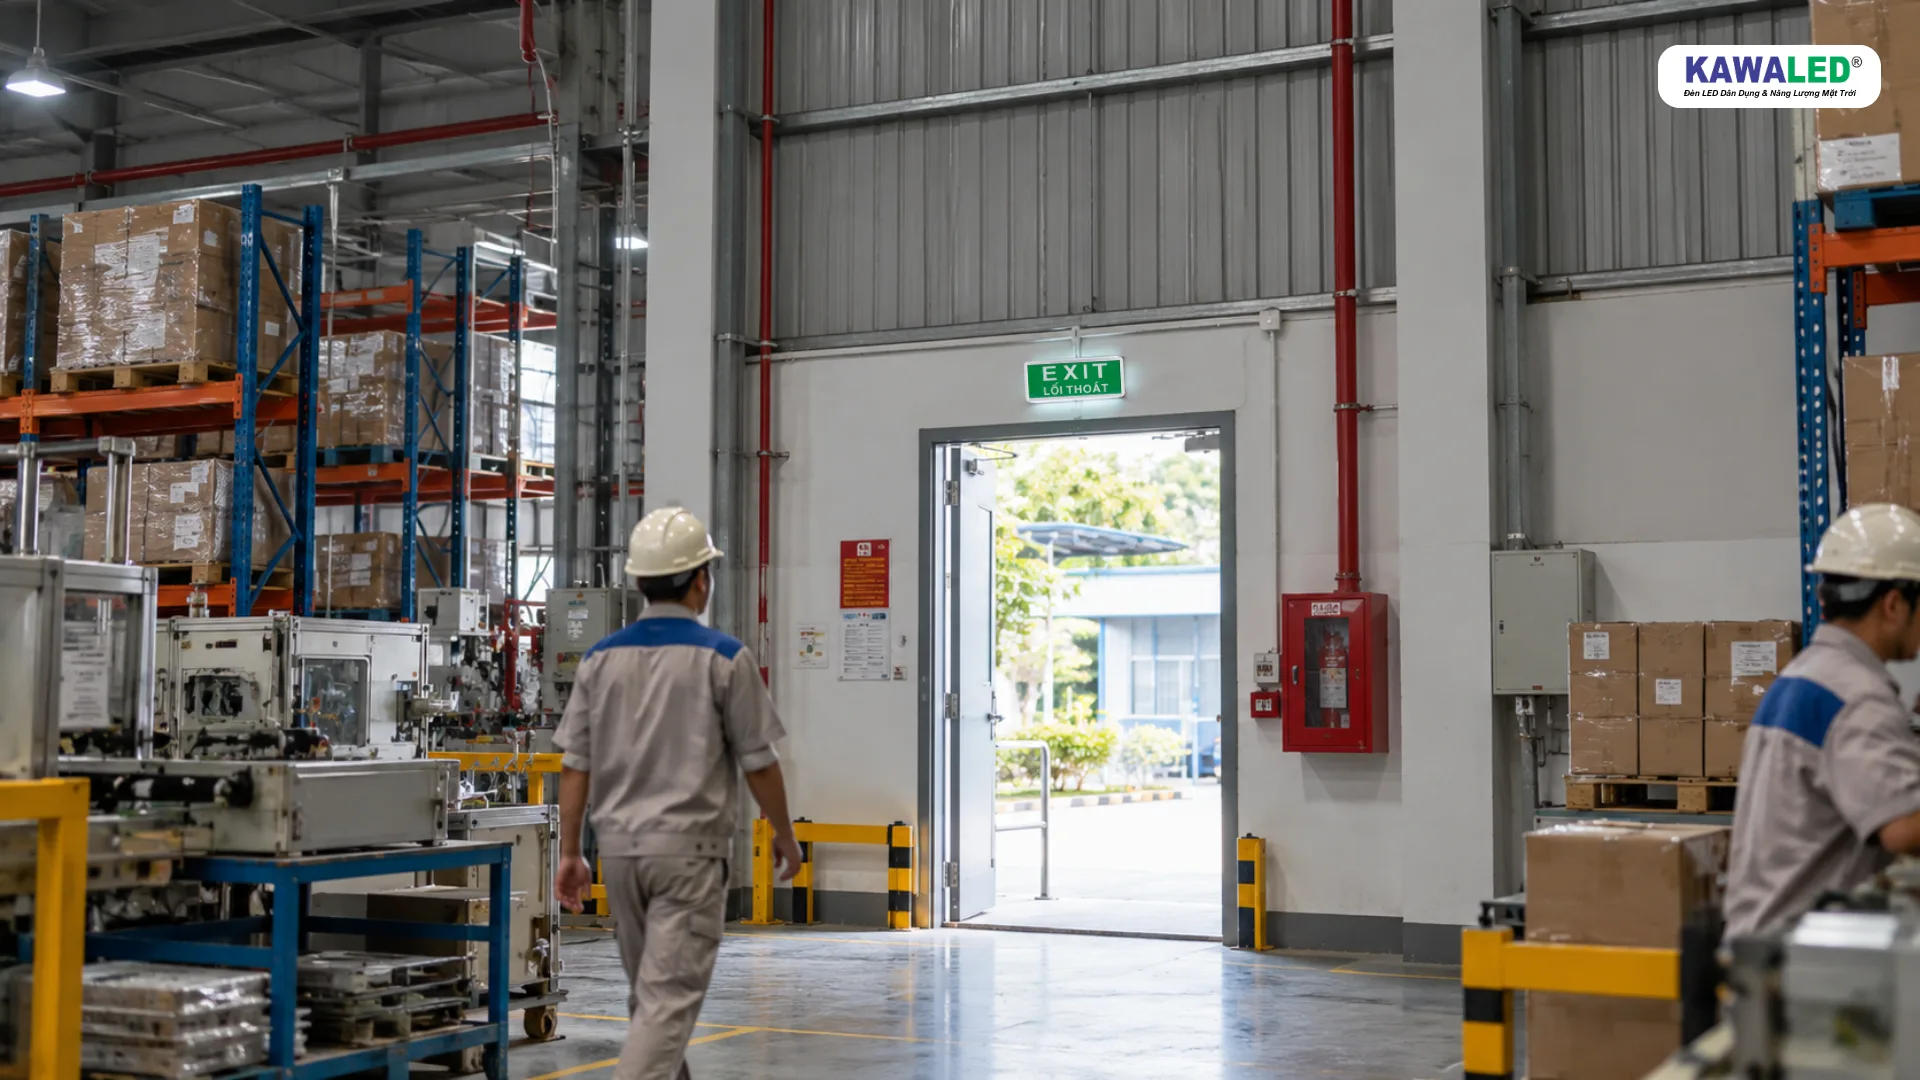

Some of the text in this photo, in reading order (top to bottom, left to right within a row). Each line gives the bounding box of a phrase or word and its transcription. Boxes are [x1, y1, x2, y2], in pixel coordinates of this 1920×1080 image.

[1042, 363, 1108, 382] EXIT
[1043, 381, 1109, 396] LỐI THOÁT
